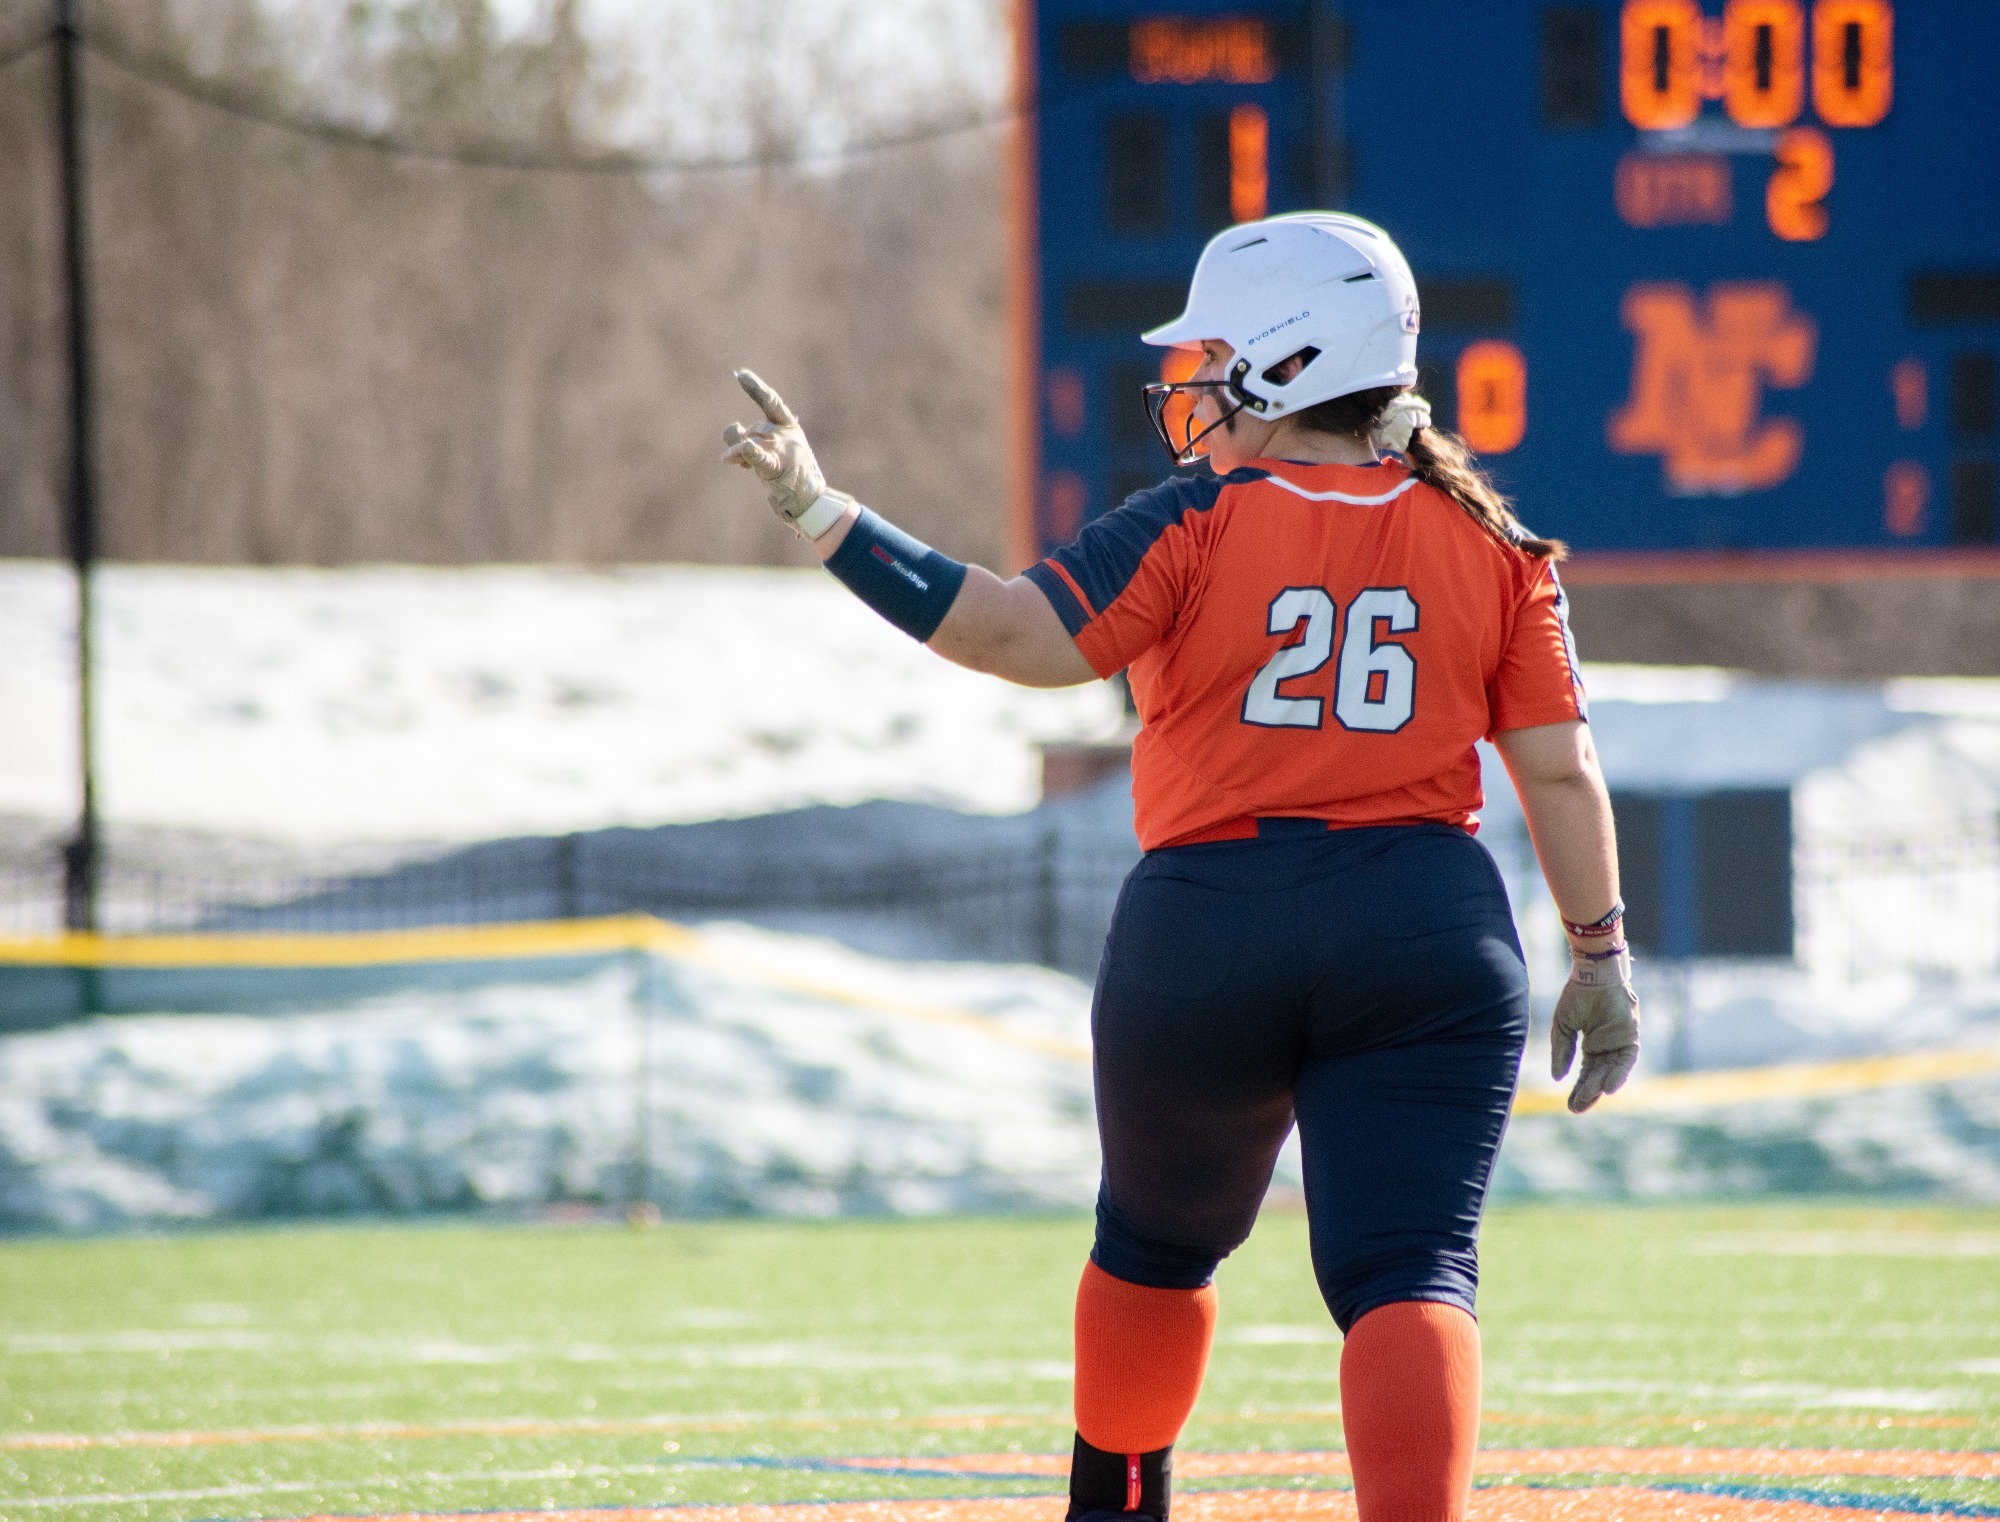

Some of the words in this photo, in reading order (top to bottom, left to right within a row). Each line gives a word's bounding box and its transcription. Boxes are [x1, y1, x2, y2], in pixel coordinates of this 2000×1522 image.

[1620, 0, 1894, 129] 0:00
[1247, 310, 1311, 346] EVOSHIELD
[1608, 280, 1817, 492] NC
[1239, 585, 1420, 735] 26
